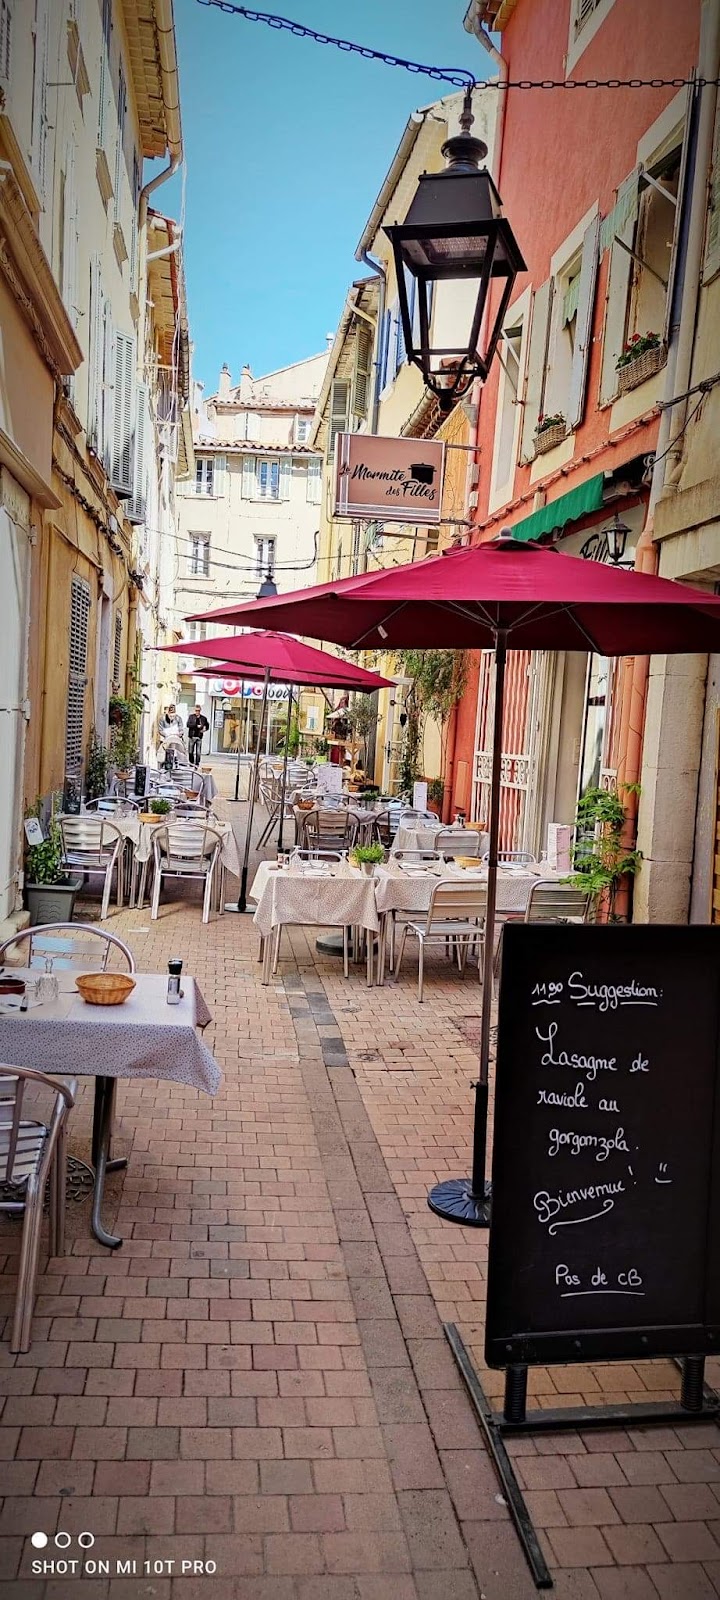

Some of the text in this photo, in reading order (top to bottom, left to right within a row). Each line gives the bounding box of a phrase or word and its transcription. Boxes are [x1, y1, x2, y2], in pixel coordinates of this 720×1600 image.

[353, 464, 406, 481] Marmite
[401, 480, 438, 501] Filles
[567, 971, 663, 1012] Suggestion:
[629, 1052, 650, 1073] de
[598, 1098, 620, 1113] au
[555, 1263, 581, 1286] Pas
[591, 1266, 608, 1286] de
